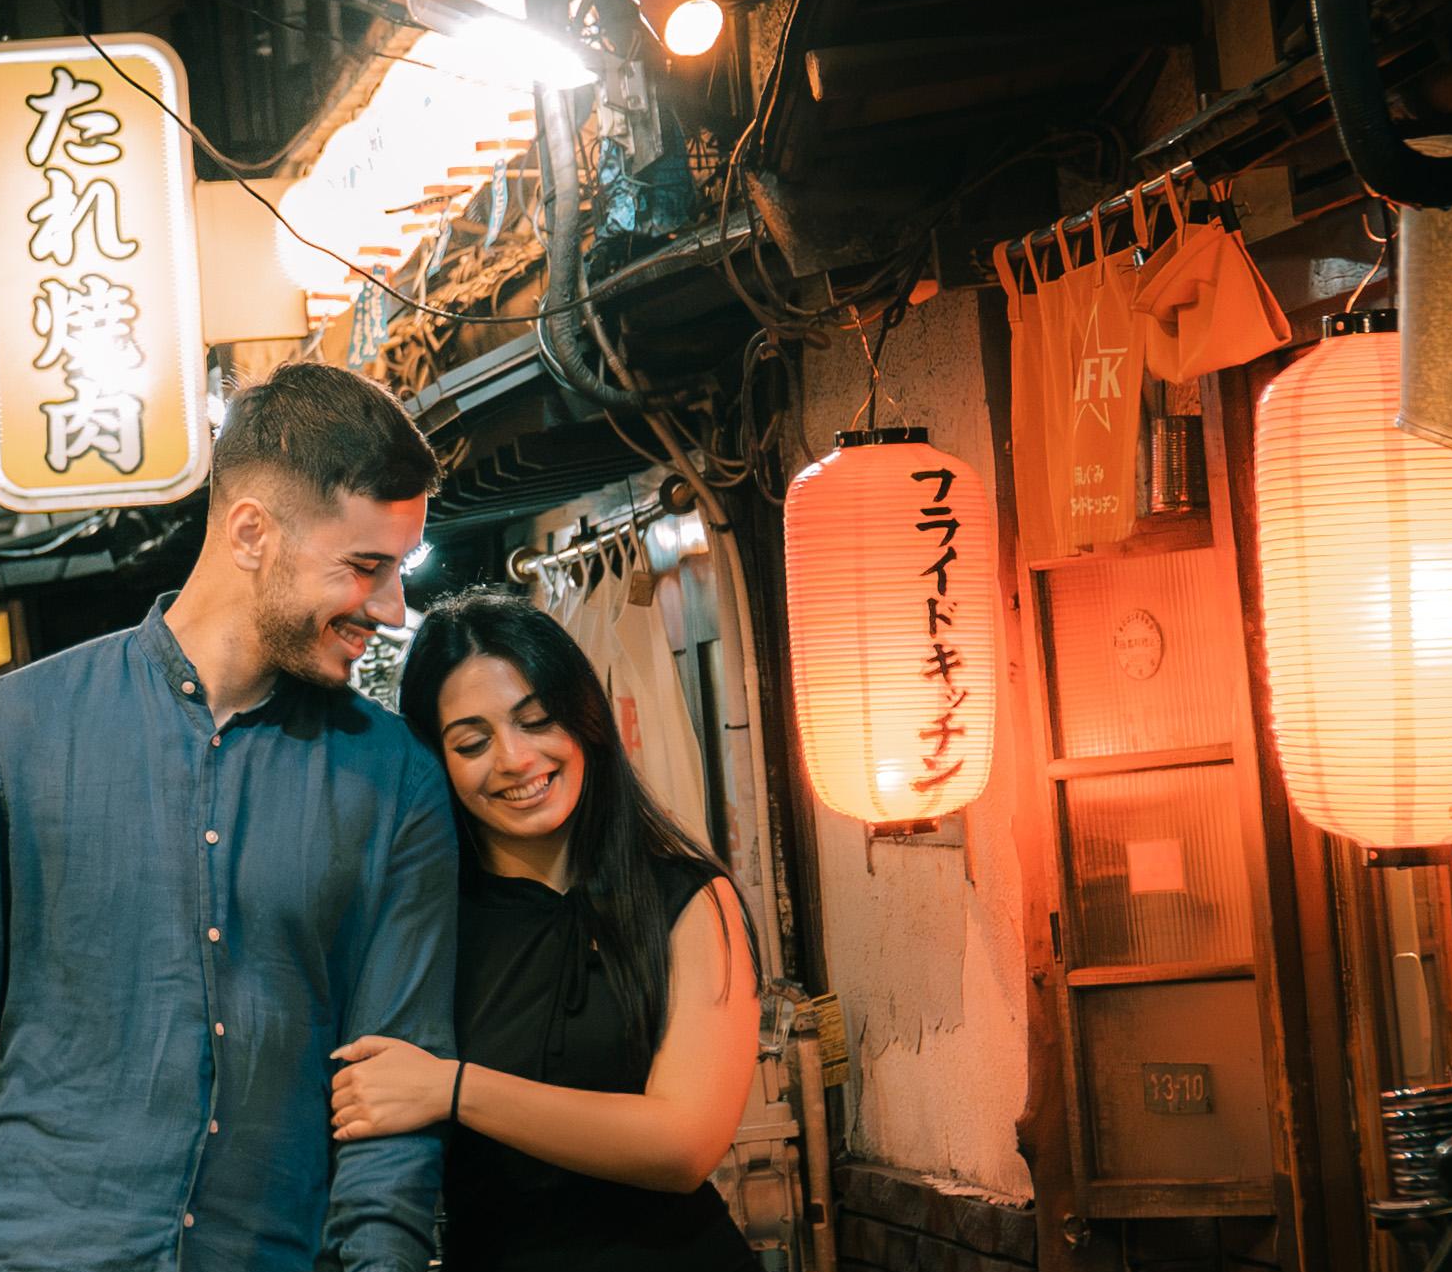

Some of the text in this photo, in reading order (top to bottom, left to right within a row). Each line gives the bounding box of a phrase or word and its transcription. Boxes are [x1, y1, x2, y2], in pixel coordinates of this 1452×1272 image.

[24, 66, 143, 476] たれ焼肉
[908, 466, 964, 795] フライドキッチン
